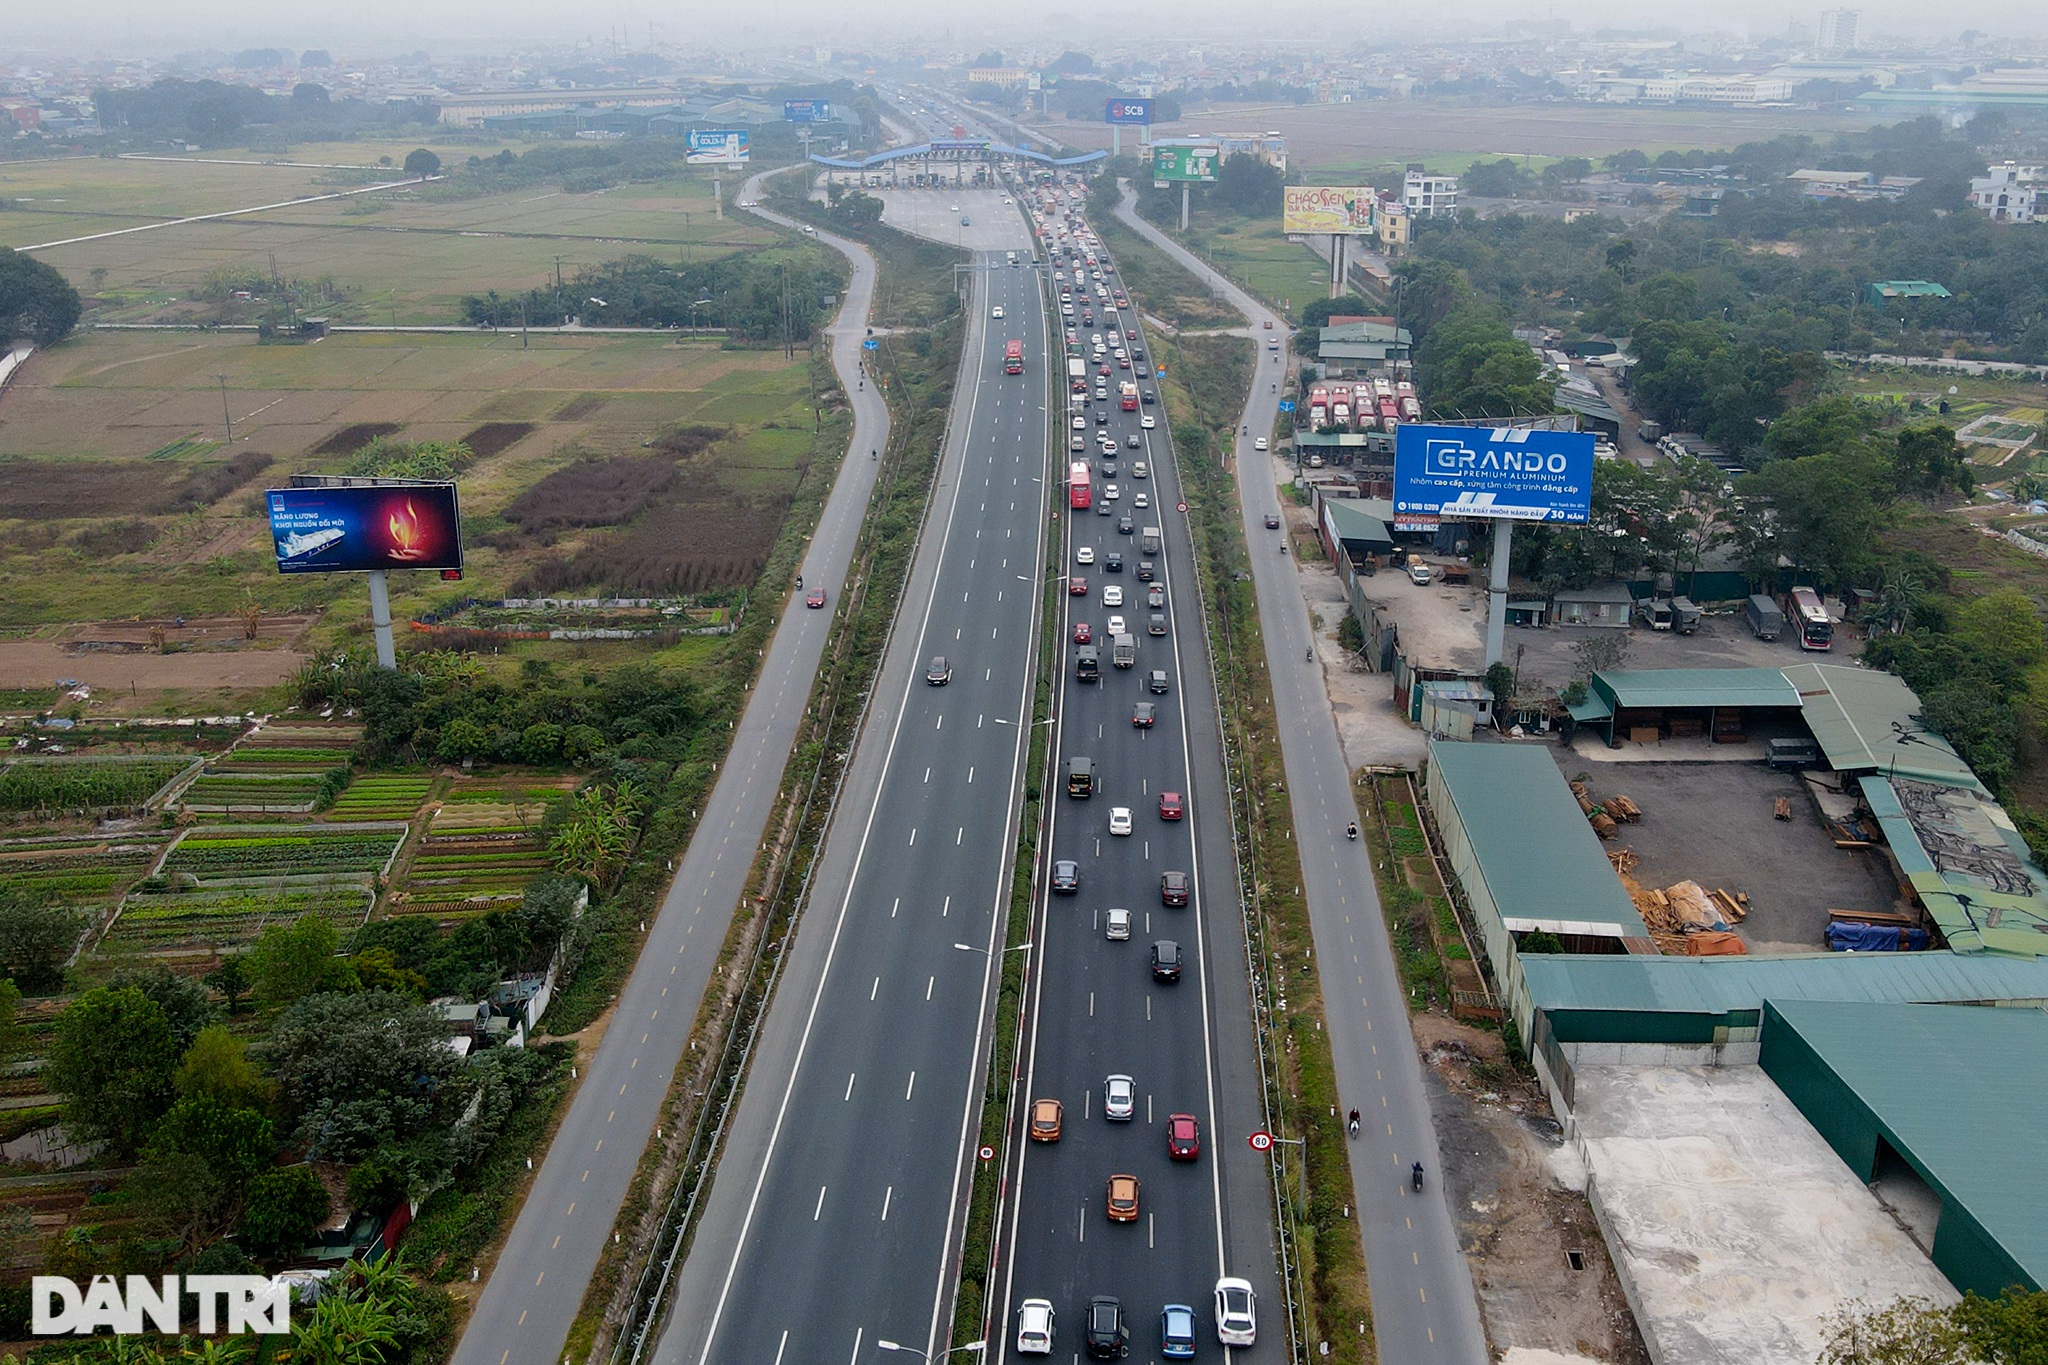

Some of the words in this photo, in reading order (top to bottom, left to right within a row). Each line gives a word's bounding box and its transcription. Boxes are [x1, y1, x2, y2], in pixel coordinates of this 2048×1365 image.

[1124, 105, 1144, 116] SCB
[1287, 190, 1320, 204] CHÁO
[1437, 448, 1567, 473] GRANDO
[1463, 470, 1507, 479] PREMIUM
[1510, 472, 1566, 482] ALUMINIUM
[1410, 477, 1433, 485] Nhôm
[1467, 479, 1486, 490] xứng
[1503, 481, 1522, 491] công
[1522, 481, 1541, 491] trình
[1550, 510, 1565, 519] 30
